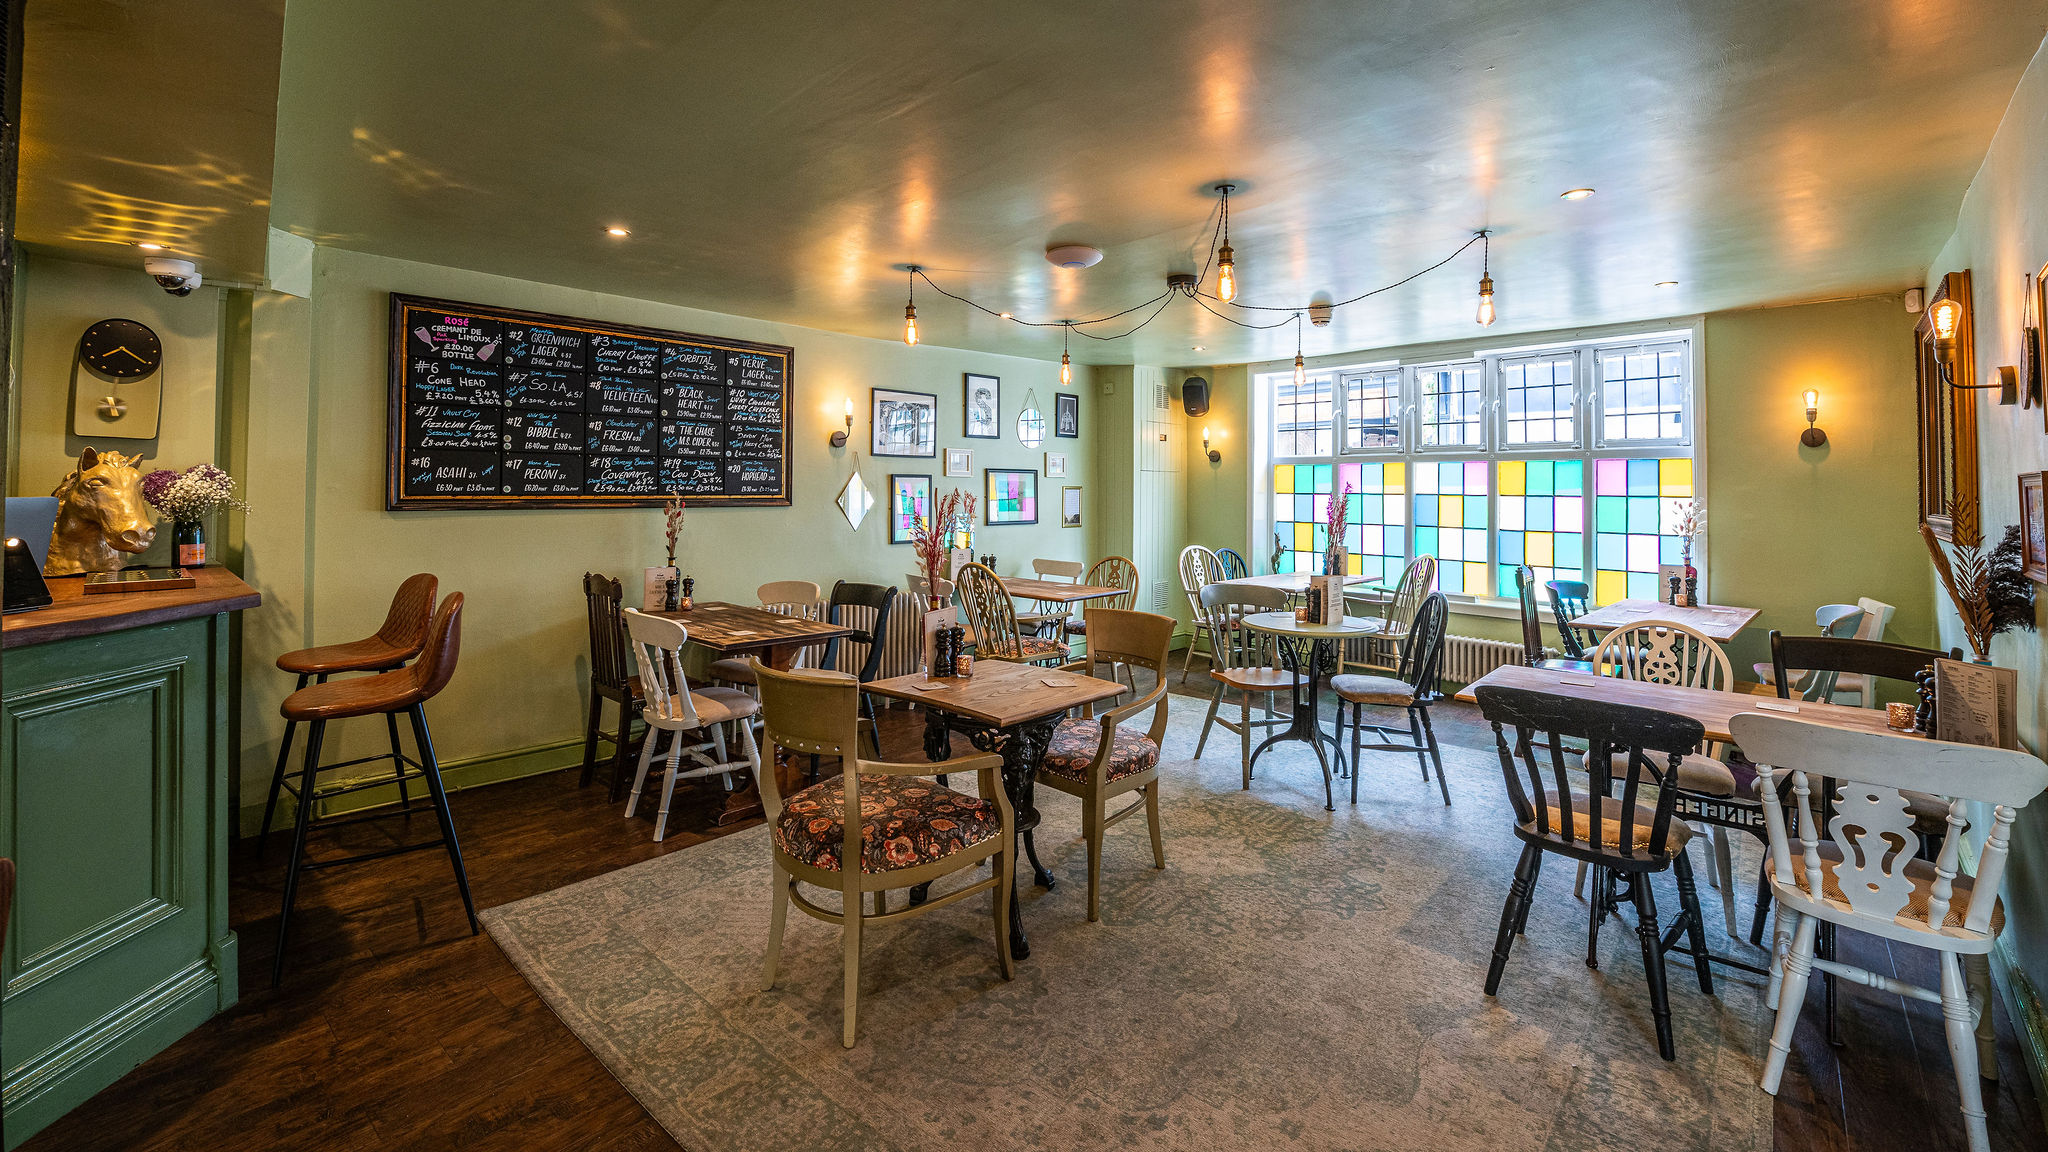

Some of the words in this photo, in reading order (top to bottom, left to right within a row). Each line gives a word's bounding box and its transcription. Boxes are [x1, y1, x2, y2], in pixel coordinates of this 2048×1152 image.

[431, 325, 468, 333] CREMANT
[458, 334, 491, 343] LIMOUX
[509, 331, 523, 341] #2
[531, 333, 580, 348] GREENWICH
[592, 336, 609, 346] #3
[444, 344, 473, 352] £20.00
[531, 345, 558, 357] LAGER
[442, 351, 474, 360] BOTTLE
[680, 354, 714, 365] ORBITAL
[414, 360, 439, 373] #6
[729, 358, 739, 366] #5
[743, 359, 765, 369] VERVE
[508, 372, 528, 383] #7
[742, 369, 765, 379] LAGER
[460, 377, 486, 387] HEAD
[589, 381, 601, 390] #8
[604, 390, 652, 403] VELVETEEN
[663, 388, 674, 396] #9
[679, 389, 704, 399] BLACK
[730, 389, 745, 397] #10
[678, 399, 704, 409] HEART
[415, 406, 439, 417] #11
[506, 417, 522, 427] #12
[589, 421, 602, 431] #13
[527, 427, 560, 438] BIBBLE
[603, 430, 633, 440] FRESH
[680, 426, 694, 435] THE
[695, 427, 715, 436] CHASE
[692, 437, 711, 447] CIDER
[411, 457, 430, 468] #16
[506, 459, 522, 469] #17
[590, 457, 611, 468] #18
[664, 459, 681, 469] #19
[436, 467, 467, 478] ASAHI
[524, 469, 558, 479] PERONI
[728, 465, 740, 473] #20
[742, 472, 767, 481] HOPHEAD
